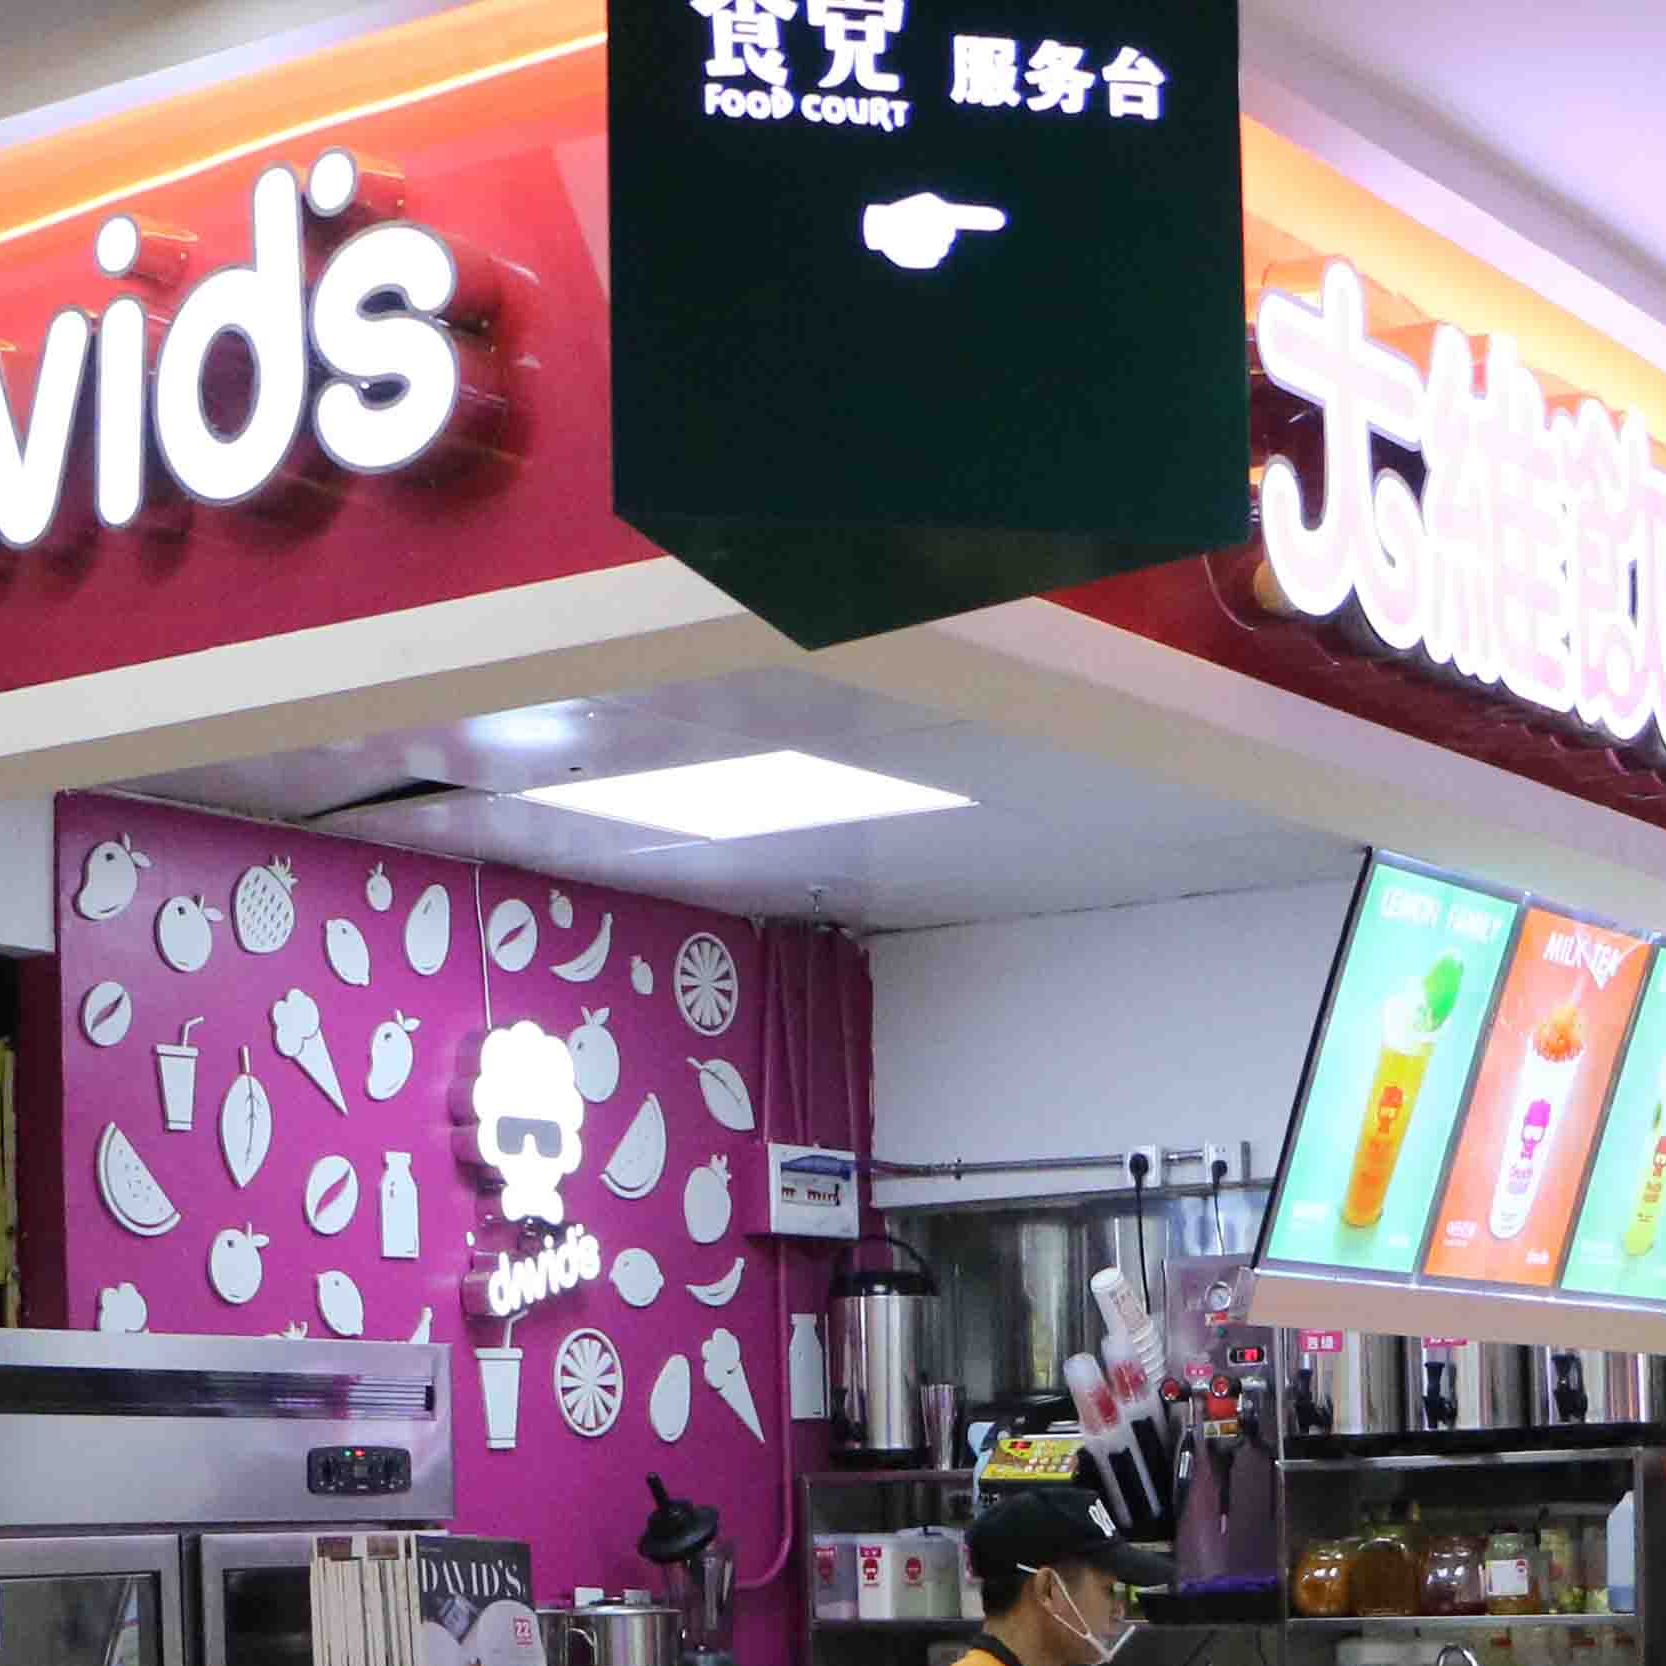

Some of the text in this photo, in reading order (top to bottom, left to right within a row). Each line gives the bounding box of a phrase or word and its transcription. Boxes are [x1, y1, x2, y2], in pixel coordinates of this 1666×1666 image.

[704, 83, 910, 133] FOOD COURT
[952, 34, 1169, 121] 服务台
